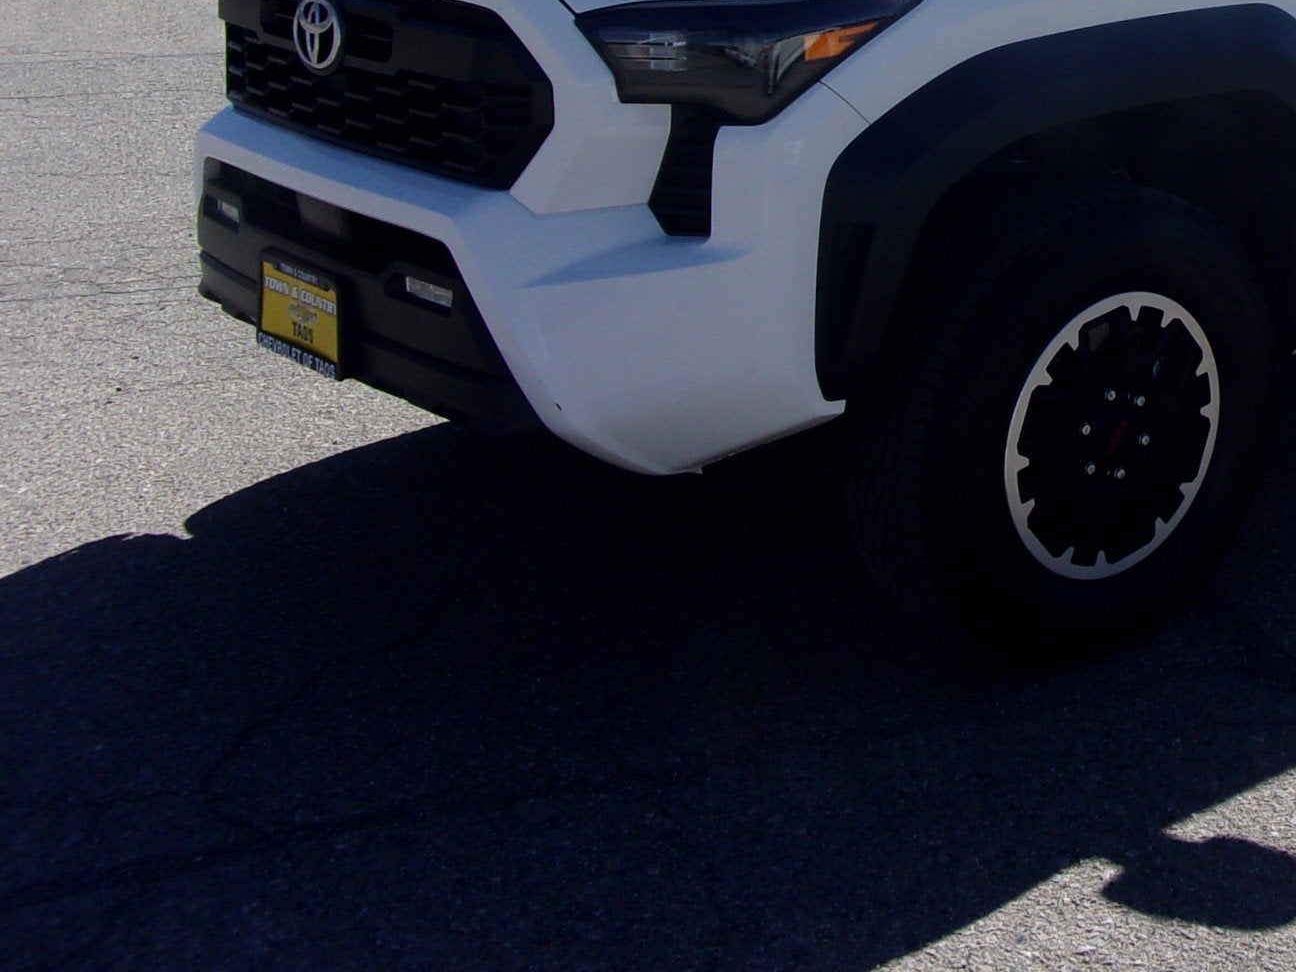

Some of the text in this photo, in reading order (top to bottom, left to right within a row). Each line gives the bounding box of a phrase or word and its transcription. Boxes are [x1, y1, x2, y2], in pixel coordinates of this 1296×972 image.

[264, 275, 337, 316] TOWN & COUNTRY
[291, 321, 314, 344] TAOS
[258, 332, 335, 379] CHEVROLET OF TAOS
